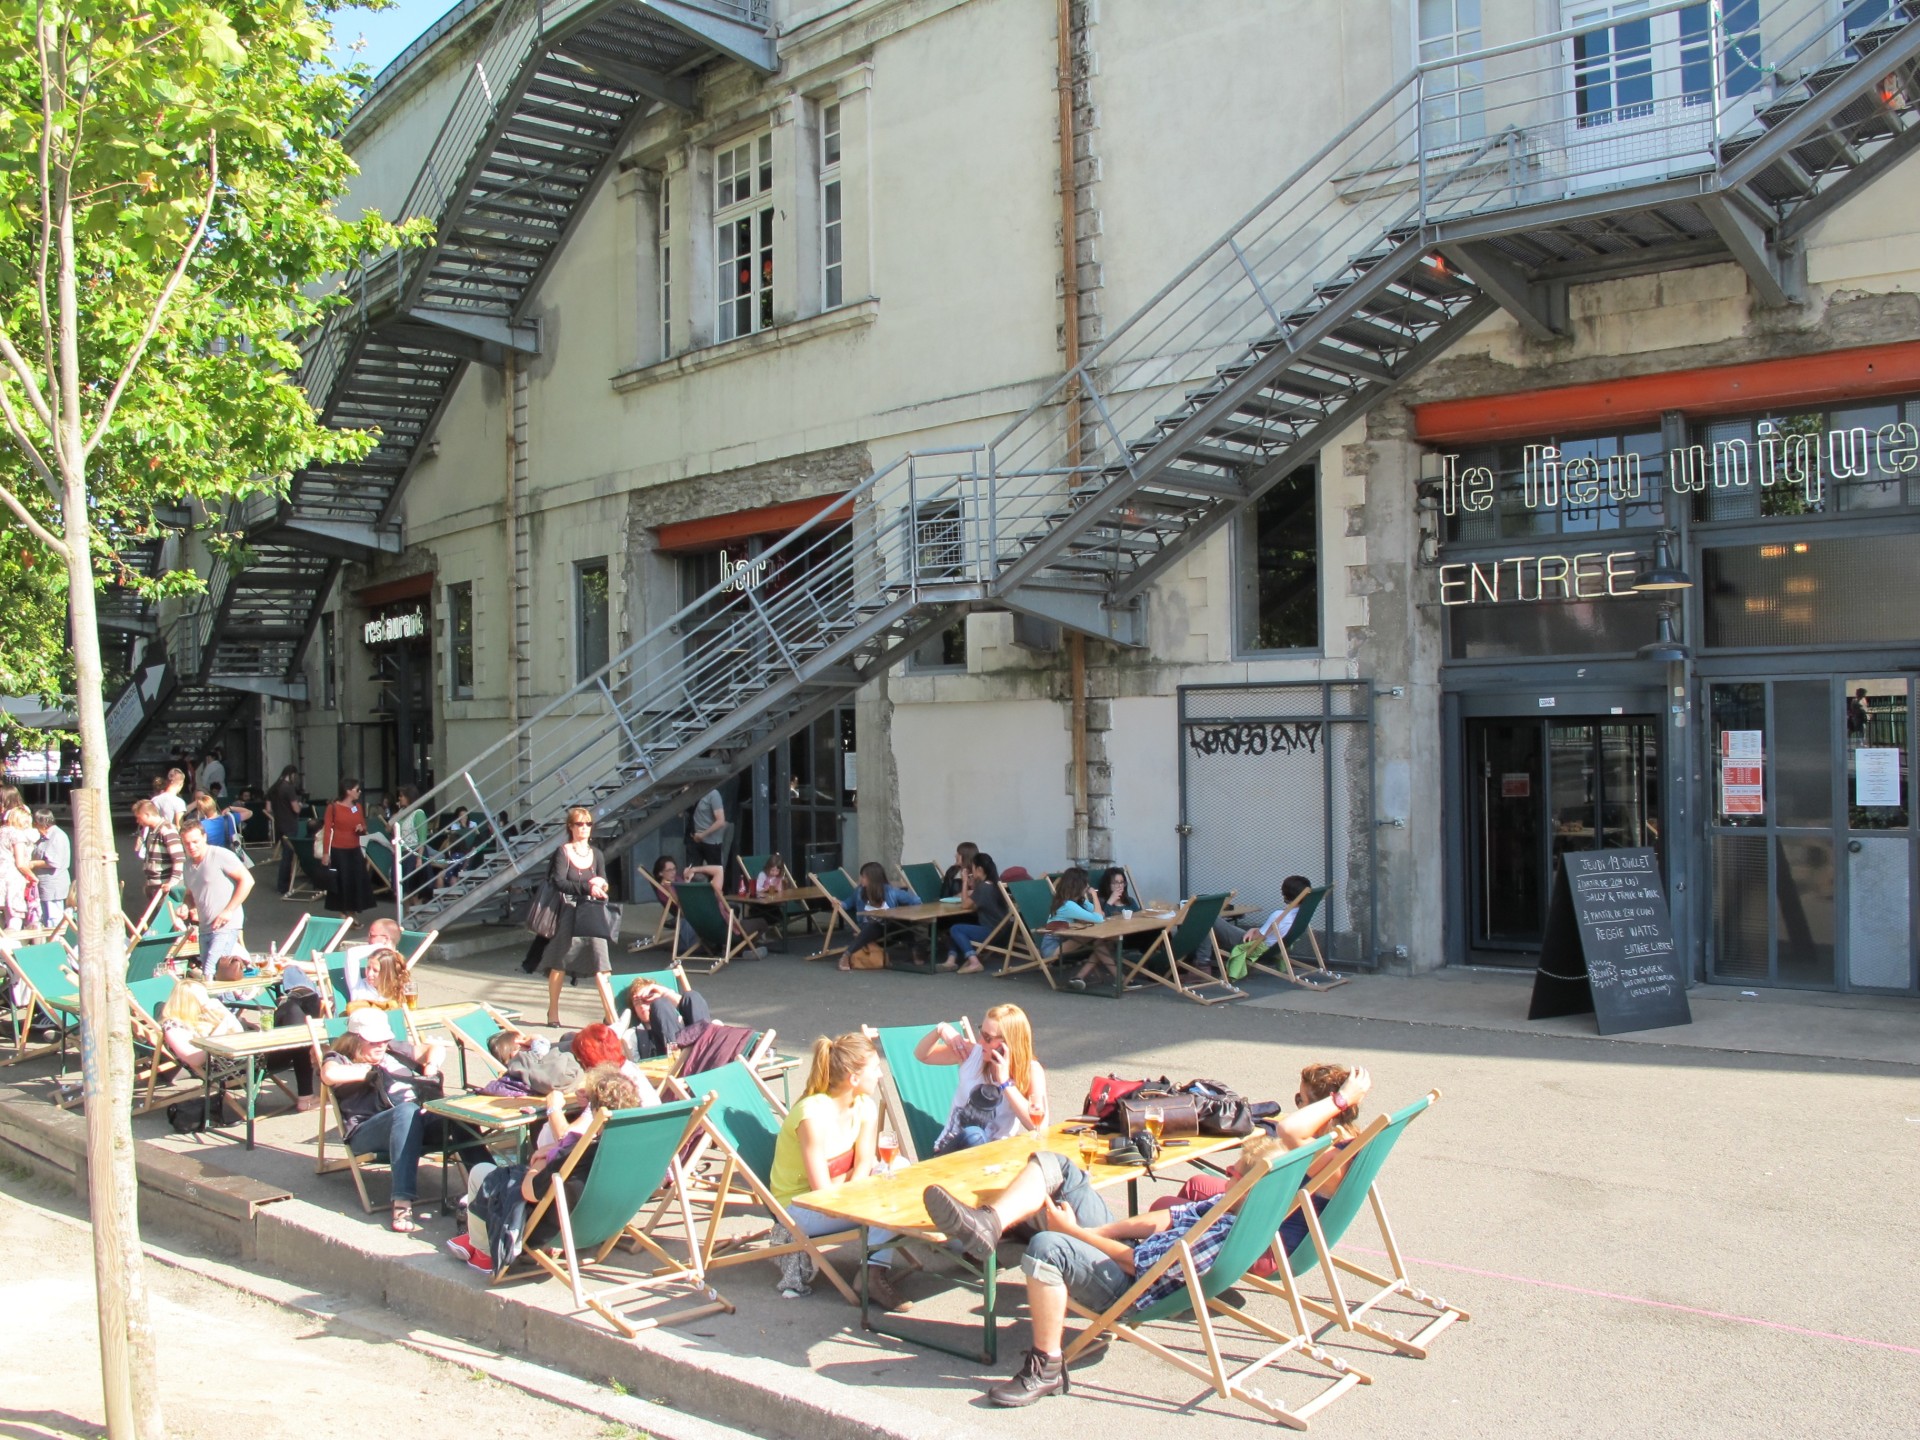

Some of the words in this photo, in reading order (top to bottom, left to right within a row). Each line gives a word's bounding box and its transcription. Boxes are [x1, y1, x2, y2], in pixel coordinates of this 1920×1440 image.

[1442, 453, 1494, 516] le
[1523, 444, 1642, 508] lieu
[1670, 421, 1920, 503] unique
[720, 550, 766, 593] bar
[1439, 551, 1639, 606] ENTREE
[364, 605, 424, 644] restaurant
[1608, 855, 1620, 870] 19
[1586, 891, 1606, 902] SALLY
[1608, 891, 1616, 902] &
[1614, 909, 1622, 918] DE
[1629, 924, 1659, 937] WATTS
